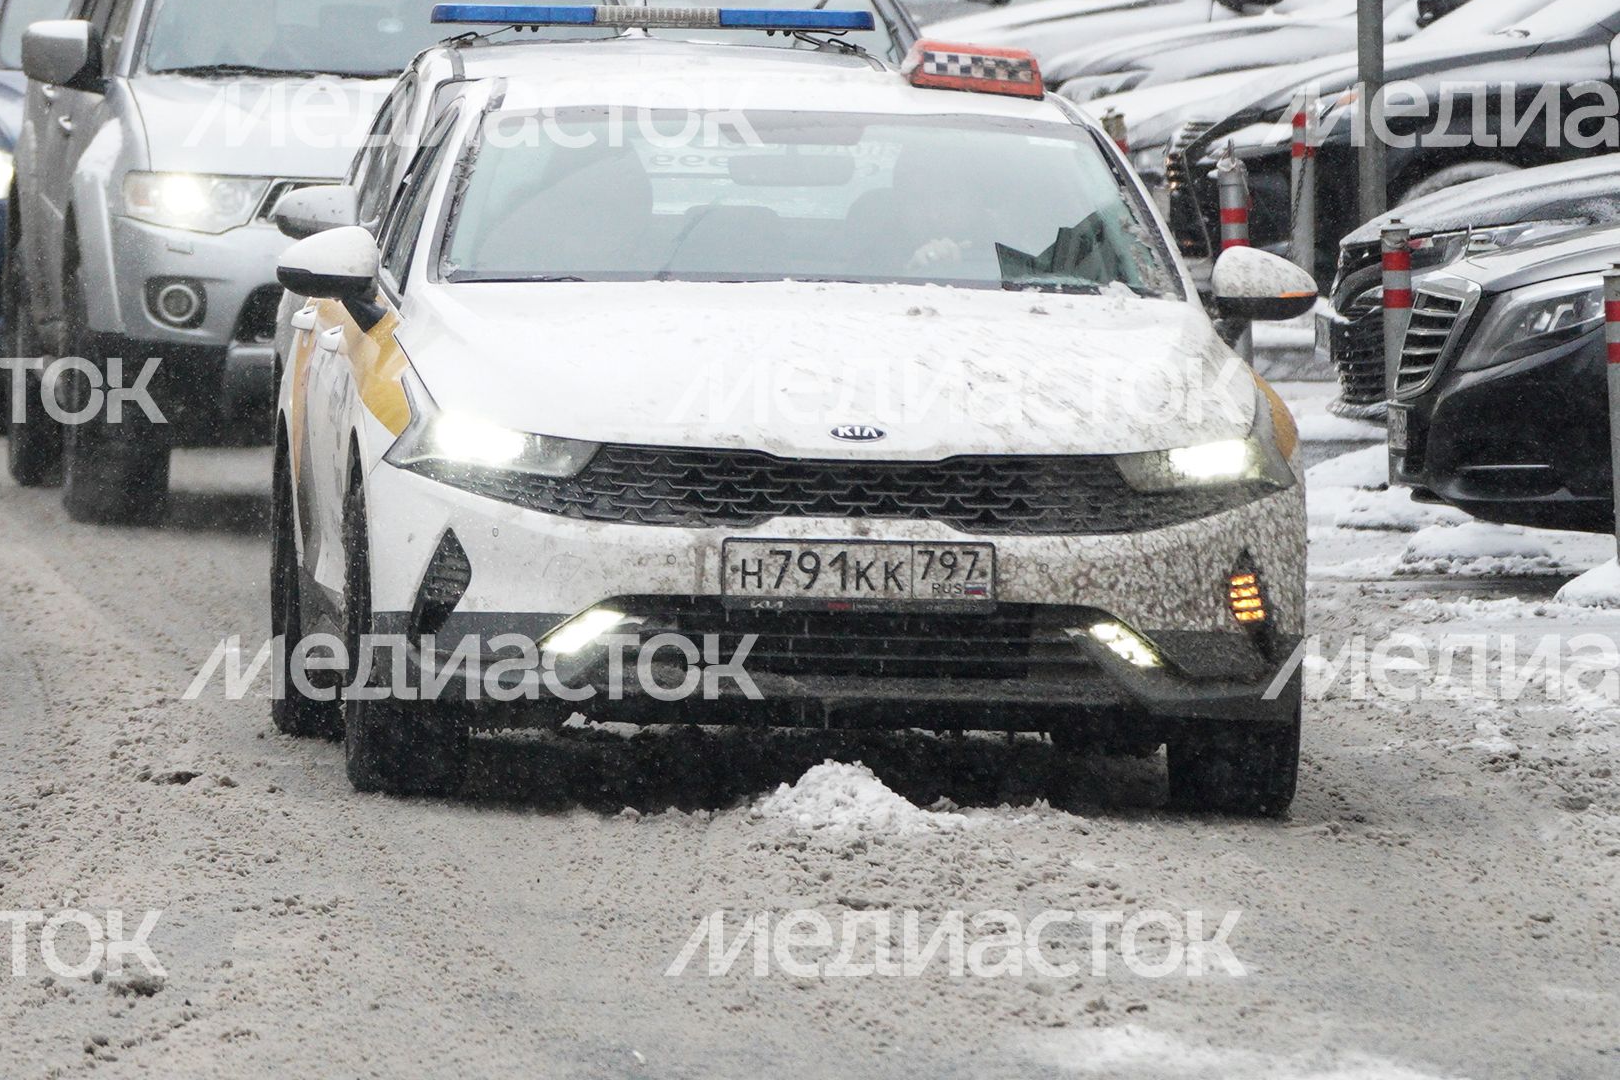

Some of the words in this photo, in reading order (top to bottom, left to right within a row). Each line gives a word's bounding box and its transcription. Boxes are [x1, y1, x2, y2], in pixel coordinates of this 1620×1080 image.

[837, 425, 878, 438] KIA
[917, 549, 980, 581] 797
[931, 582, 963, 595] RUS
